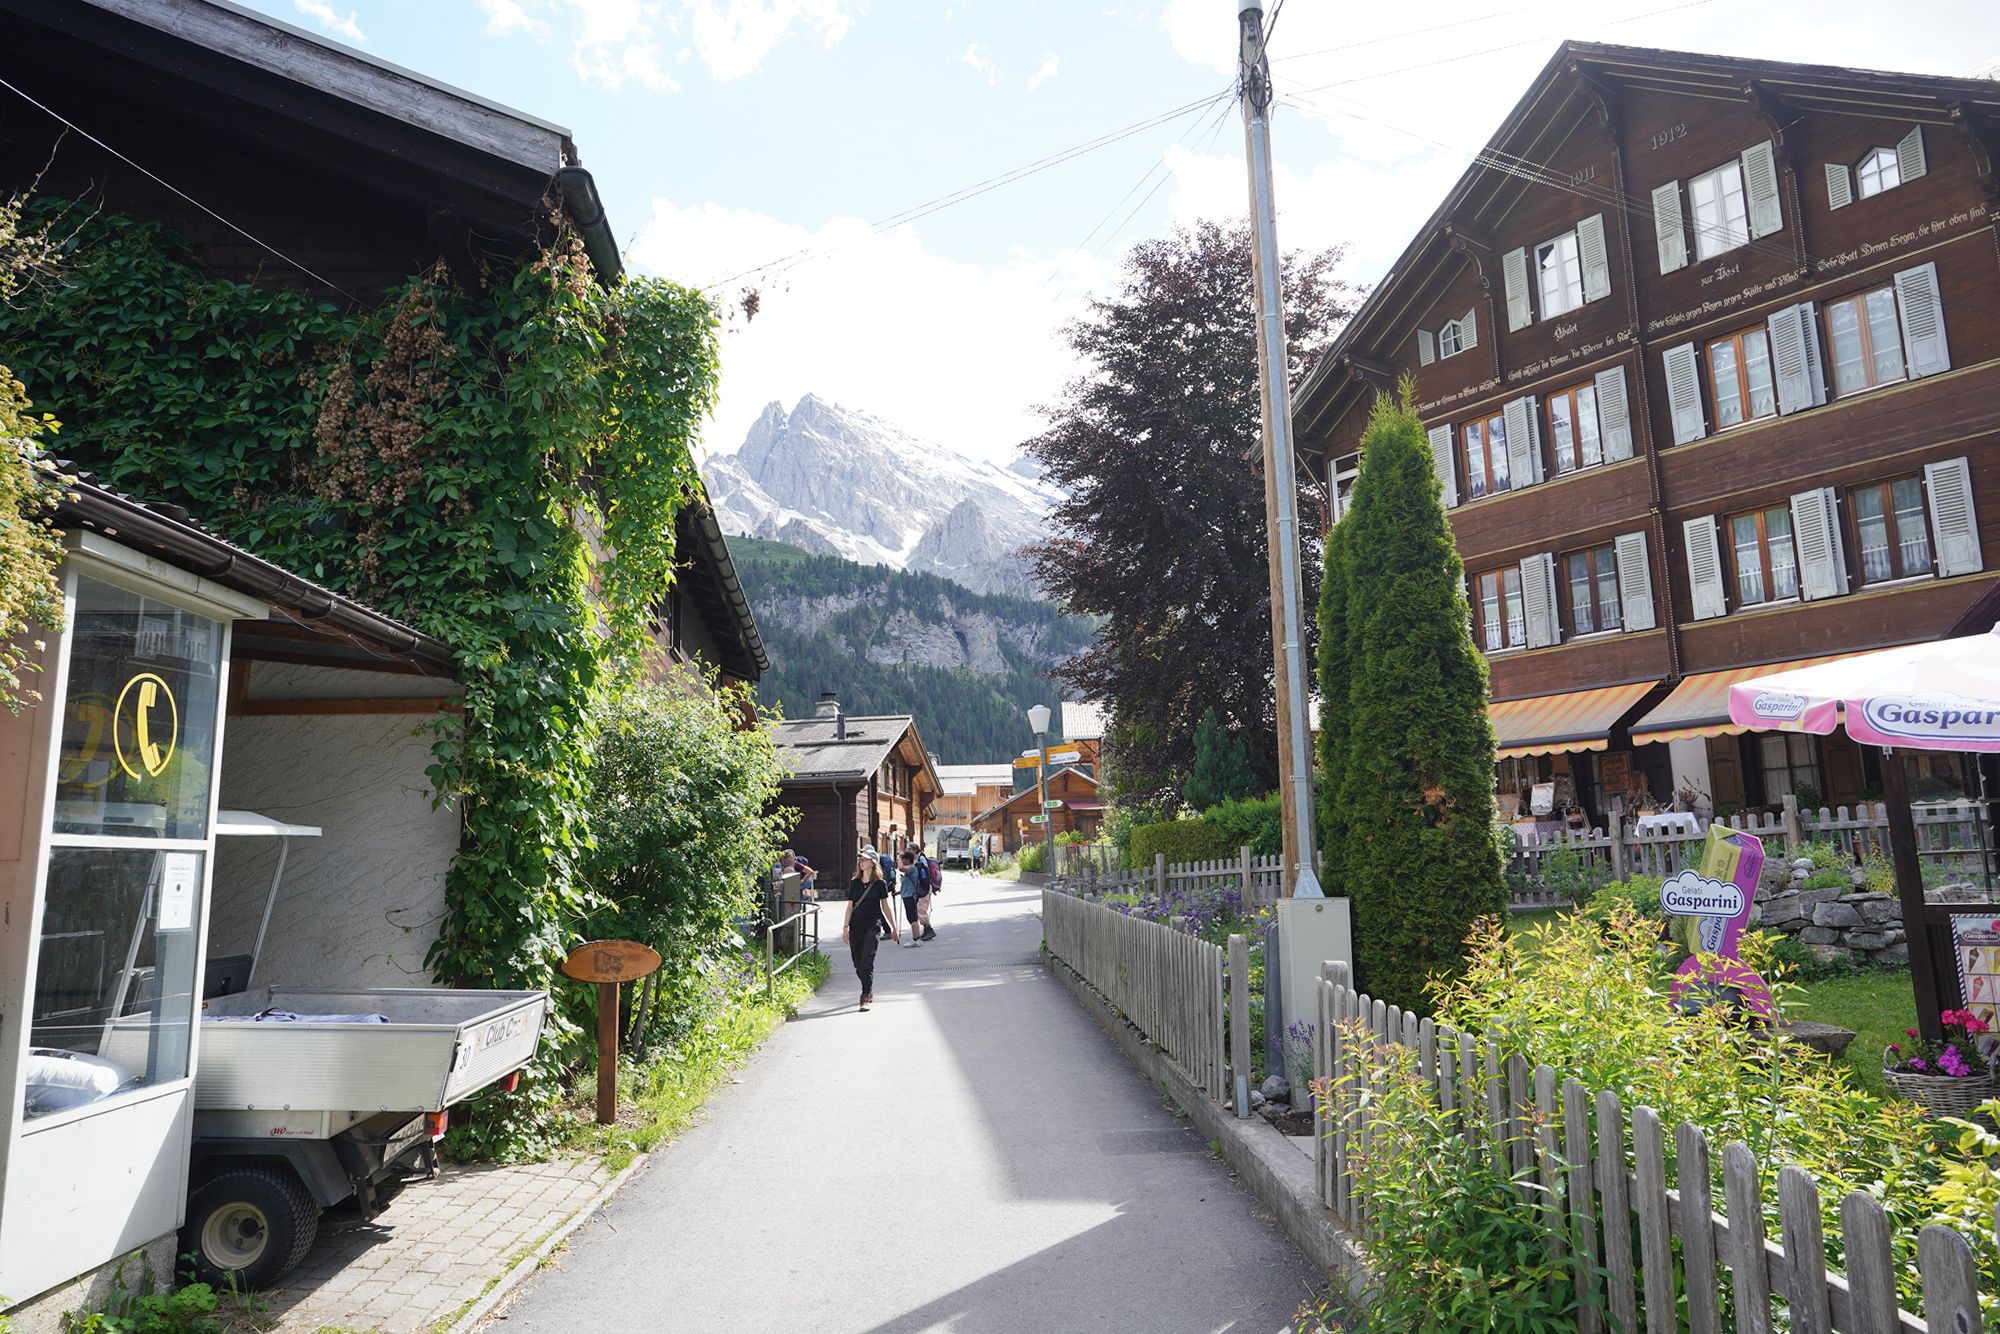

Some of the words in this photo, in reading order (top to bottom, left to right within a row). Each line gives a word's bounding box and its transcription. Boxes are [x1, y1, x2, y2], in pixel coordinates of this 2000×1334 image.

[1651, 123, 1687, 150] 1912
[1569, 165, 1596, 187] 1911
[1918, 223, 1930, 237] die
[1949, 212, 1968, 226] oben
[1701, 274, 1714, 287] zur
[1714, 262, 1740, 281] Post
[1723, 294, 1742, 308] gegen
[1755, 699, 1803, 713] Gasparini
[1877, 703, 2000, 730] Gaspar
[1666, 891, 1737, 910] Gasparini
[1682, 886, 1703, 895] Gelati
[486, 1021, 506, 1047] Club
